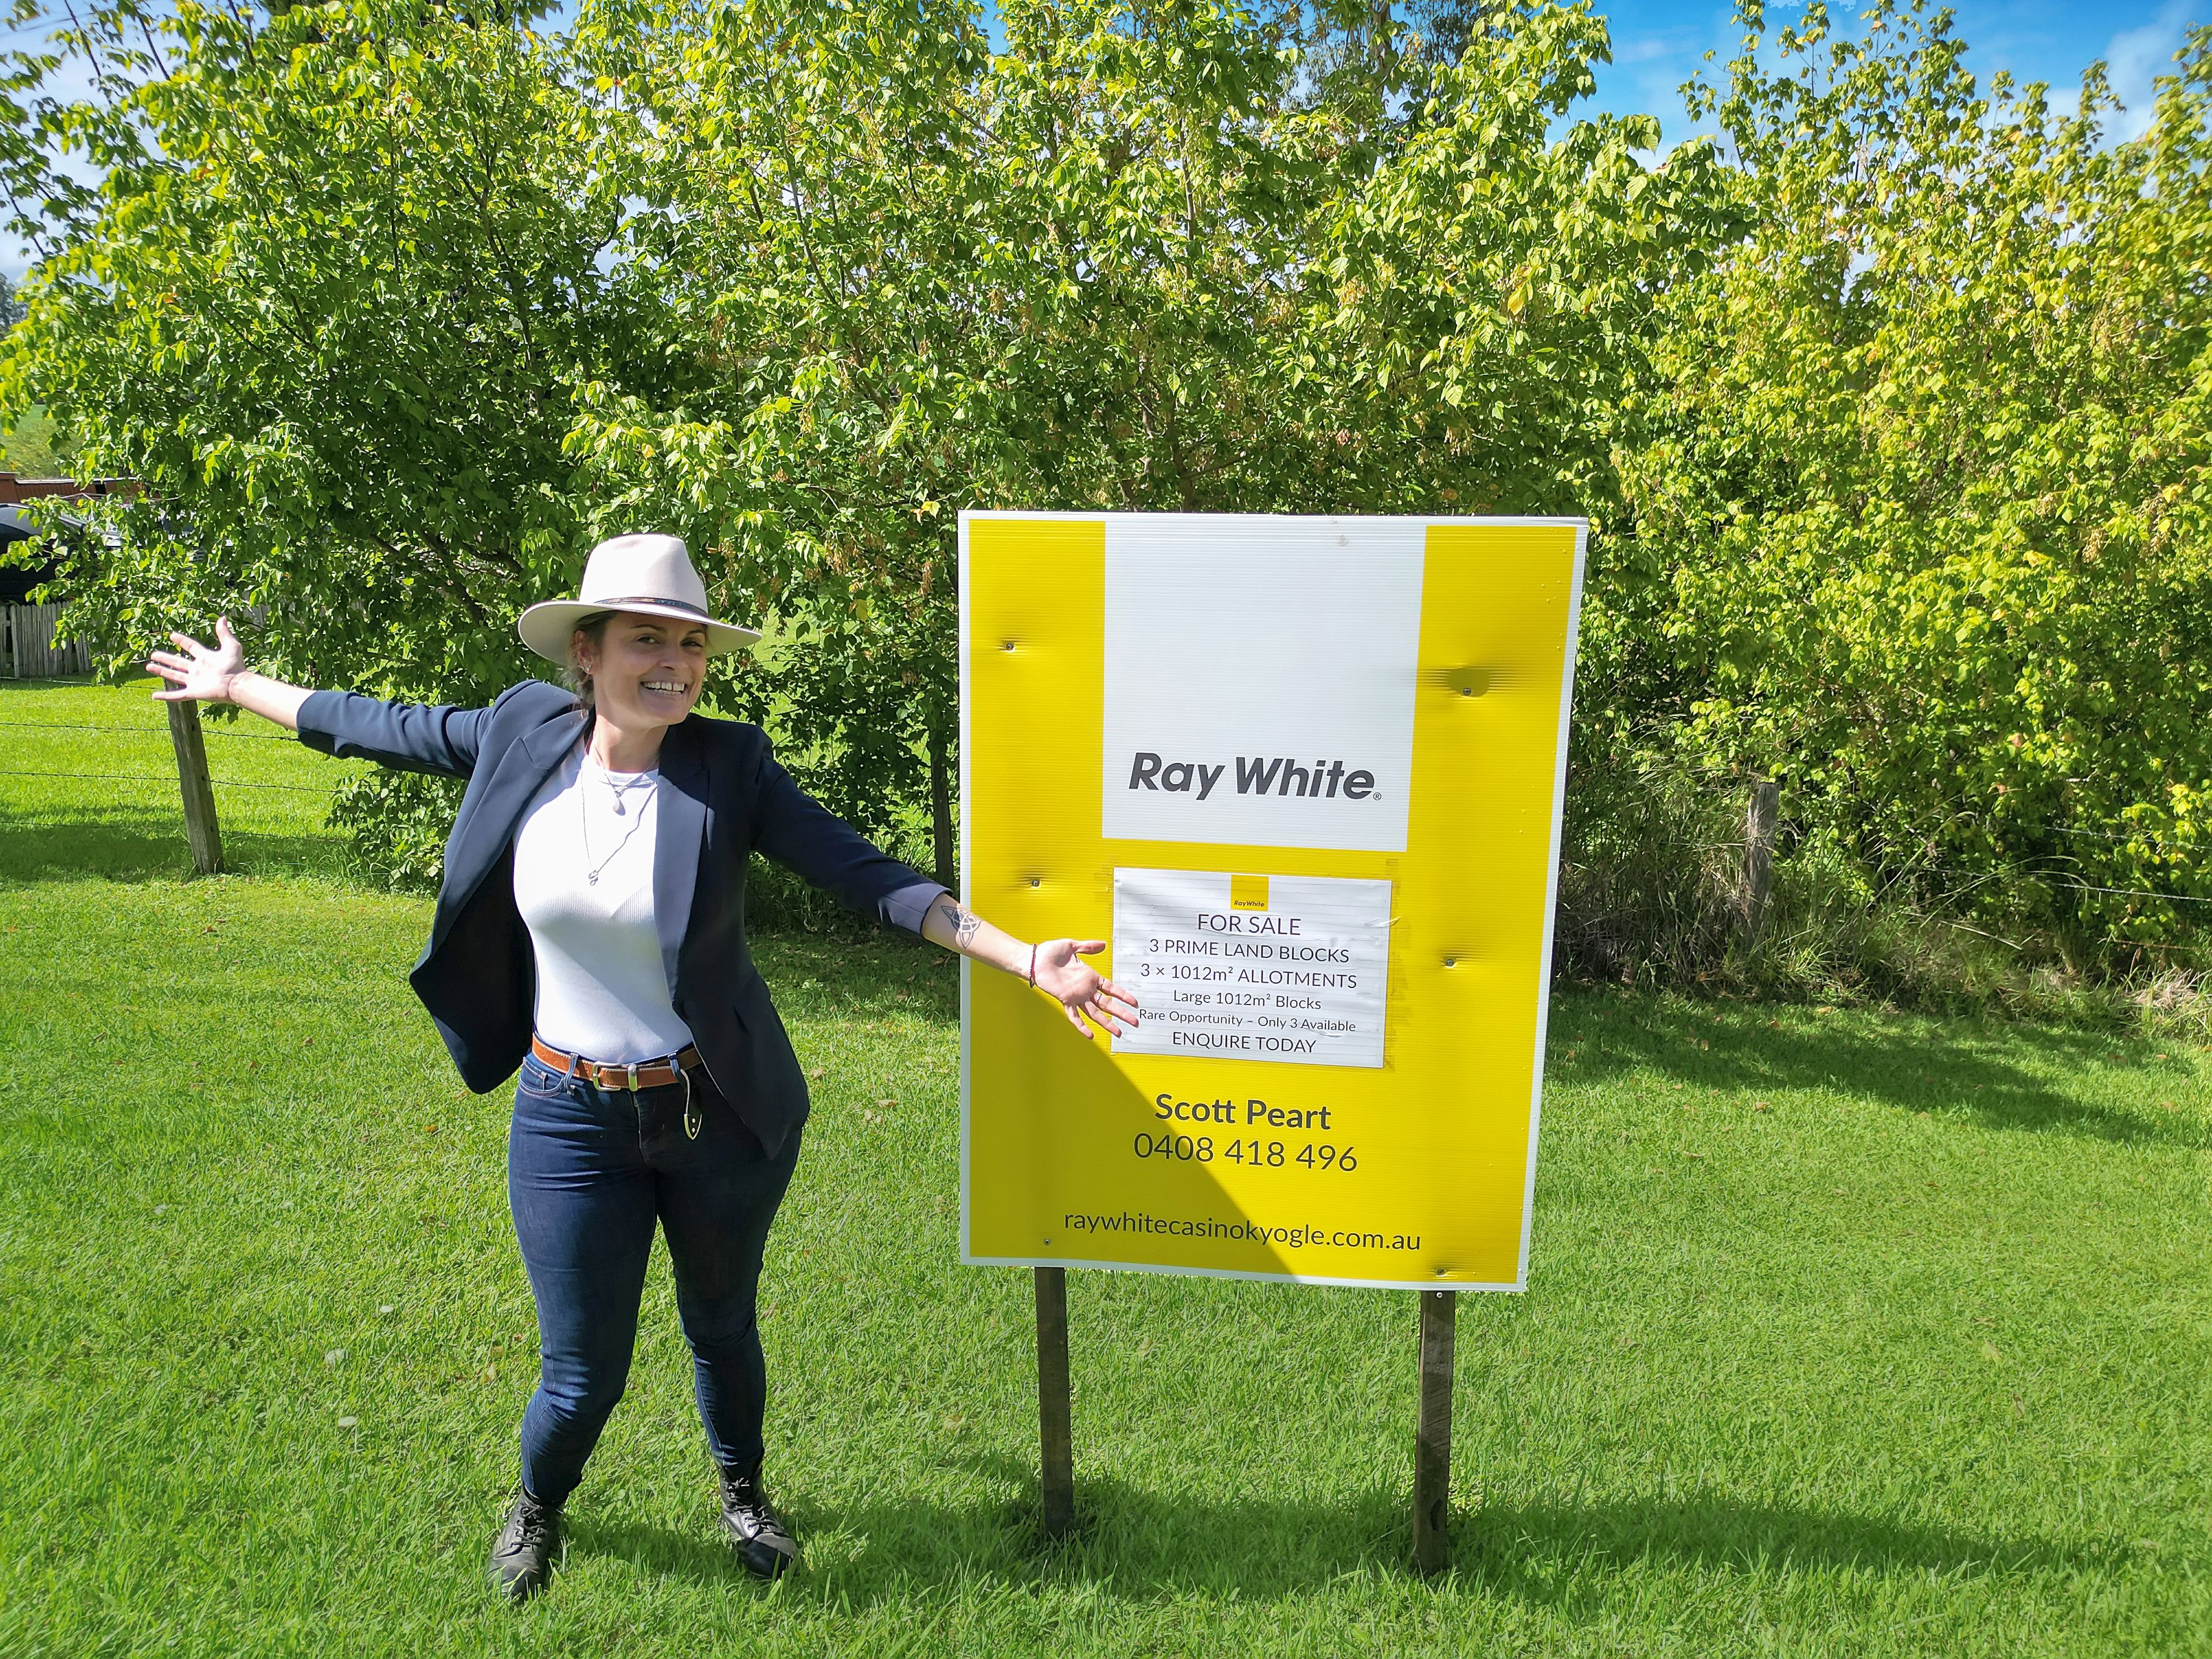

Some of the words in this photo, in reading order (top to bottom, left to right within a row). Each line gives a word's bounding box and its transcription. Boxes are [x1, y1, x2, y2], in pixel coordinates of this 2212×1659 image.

[1128, 752, 1225, 800] Ray
[1198, 914, 1241, 934] FOR
[1248, 916, 1301, 935] SALE
[1150, 939, 1158, 952] 3
[1165, 940, 1218, 956] PRIME
[1225, 943, 1273, 959] LAND
[1279, 946, 1349, 963] BLOCKS
[1141, 963, 1150, 977] 3
[1237, 968, 1357, 988] ALLOTMENTS
[1173, 990, 1211, 1006] Large
[1276, 995, 1321, 1010] Blocks
[1139, 1009, 1165, 1021] Rare
[1169, 1011, 1243, 1027] Opportunity
[1257, 1016, 1286, 1029] Only
[1290, 1018, 1298, 1028] 3
[1301, 1020, 1356, 1032] Available
[1173, 1032, 1250, 1050] ENQUIRE
[1256, 1036, 1316, 1053] TODAY
[1154, 1093, 1236, 1124] Scott
[1246, 1100, 1331, 1130] Peart
[1134, 1132, 1214, 1164] 0408
[1224, 1138, 1285, 1168] 418
[1295, 1143, 1358, 1172] 496
[1065, 1211, 1421, 1250] raywhitecasinokyogle.com.au
